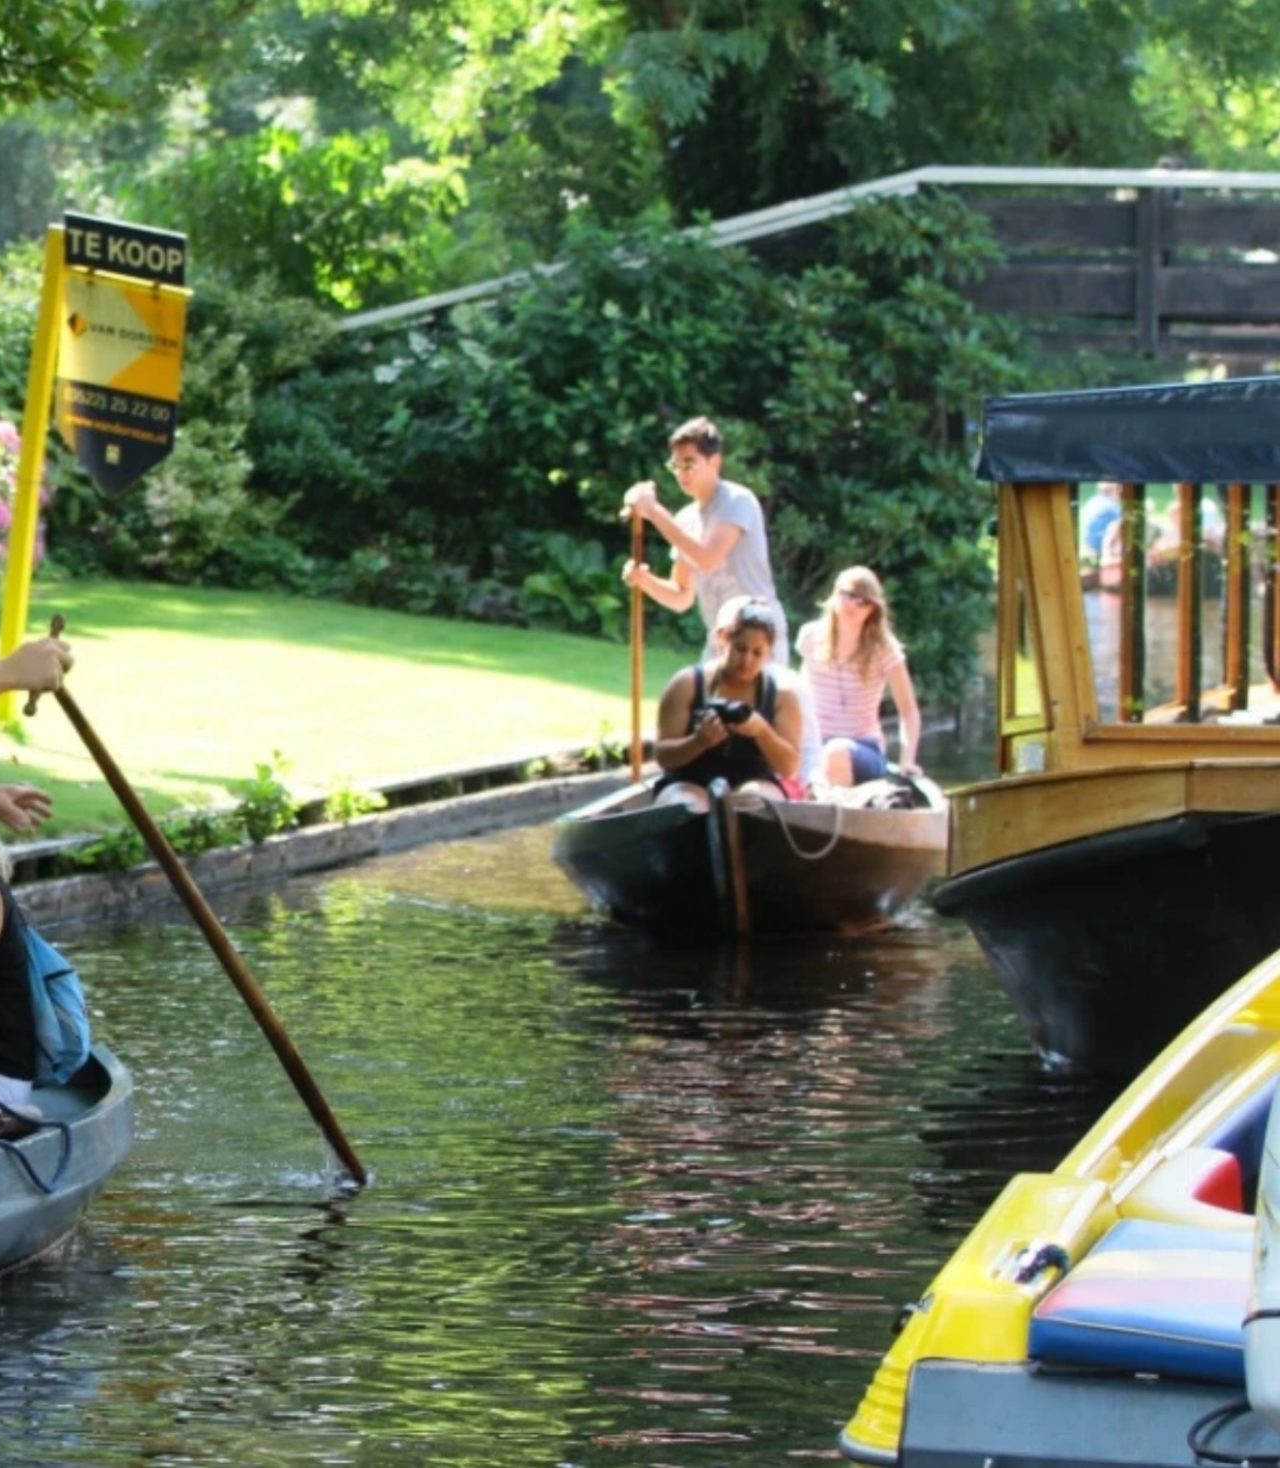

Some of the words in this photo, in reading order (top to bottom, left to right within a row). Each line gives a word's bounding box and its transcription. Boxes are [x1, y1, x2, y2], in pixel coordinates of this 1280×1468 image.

[68, 228, 101, 260] TE
[108, 236, 183, 274] KOOP
[90, 323, 116, 337] VAN
[110, 396, 128, 414] 25
[131, 401, 148, 418] 22
[151, 405, 171, 422] 00
